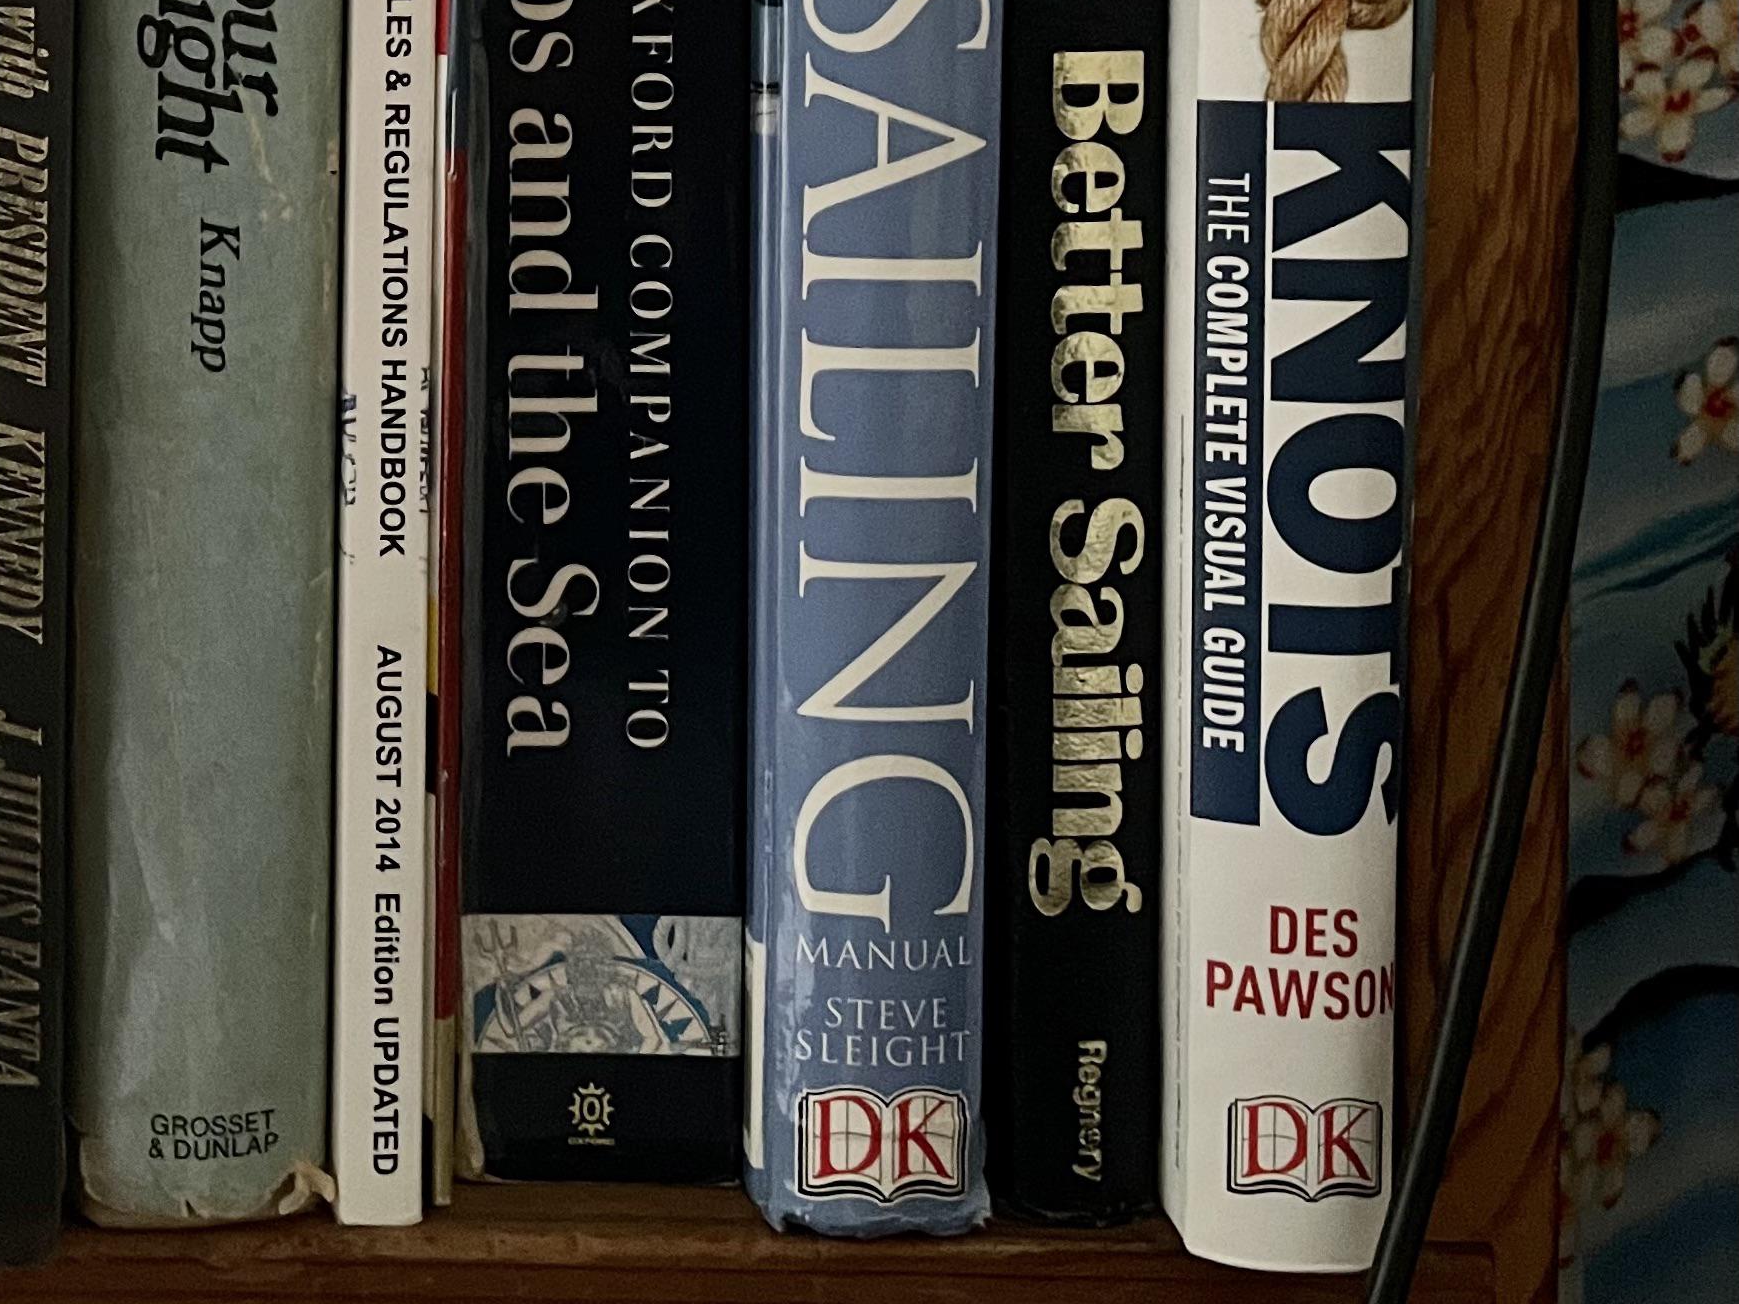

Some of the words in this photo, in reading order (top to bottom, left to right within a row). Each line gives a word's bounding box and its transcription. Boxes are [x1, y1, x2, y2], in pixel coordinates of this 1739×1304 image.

[384, 70, 411, 92] &
[381, 103, 411, 349] REGULATIONS
[508, 107, 599, 311] and
[1051, 50, 1144, 471] Better
[1207, 171, 1250, 243] THE
[191, 217, 241, 373] Knapp
[1204, 255, 1250, 465] COMPLETE
[379, 359, 407, 557] HANDBOOK
[507, 345, 598, 525] the
[627, 233, 673, 641] COMPANION
[1264, 101, 1411, 836] KNOTS
[1203, 476, 1247, 613] VISUAL
[375, 644, 402, 787] AUGUST
[506, 557, 600, 757] Sea
[626, 668, 670, 750] TO
[1028, 497, 1145, 916] Sailing
[1203, 625, 1246, 754] GUIDE
[374, 797, 402, 873] 2014
[373, 892, 401, 1006] Edition
[796, 935, 972, 972] MANUAL
[1269, 905, 1359, 958] DES
[795, 1030, 971, 1067] SLEIGHT
[825, 997, 948, 1031] STEVE
[148, 1137, 165, 1159] &
[174, 1134, 280, 1161] DUNLAP
[150, 1109, 276, 1137] GROSSET
[372, 1016, 400, 1176] UPDATED
[813, 1096, 953, 1181] DK
[1242, 1101, 1372, 1182] DK
